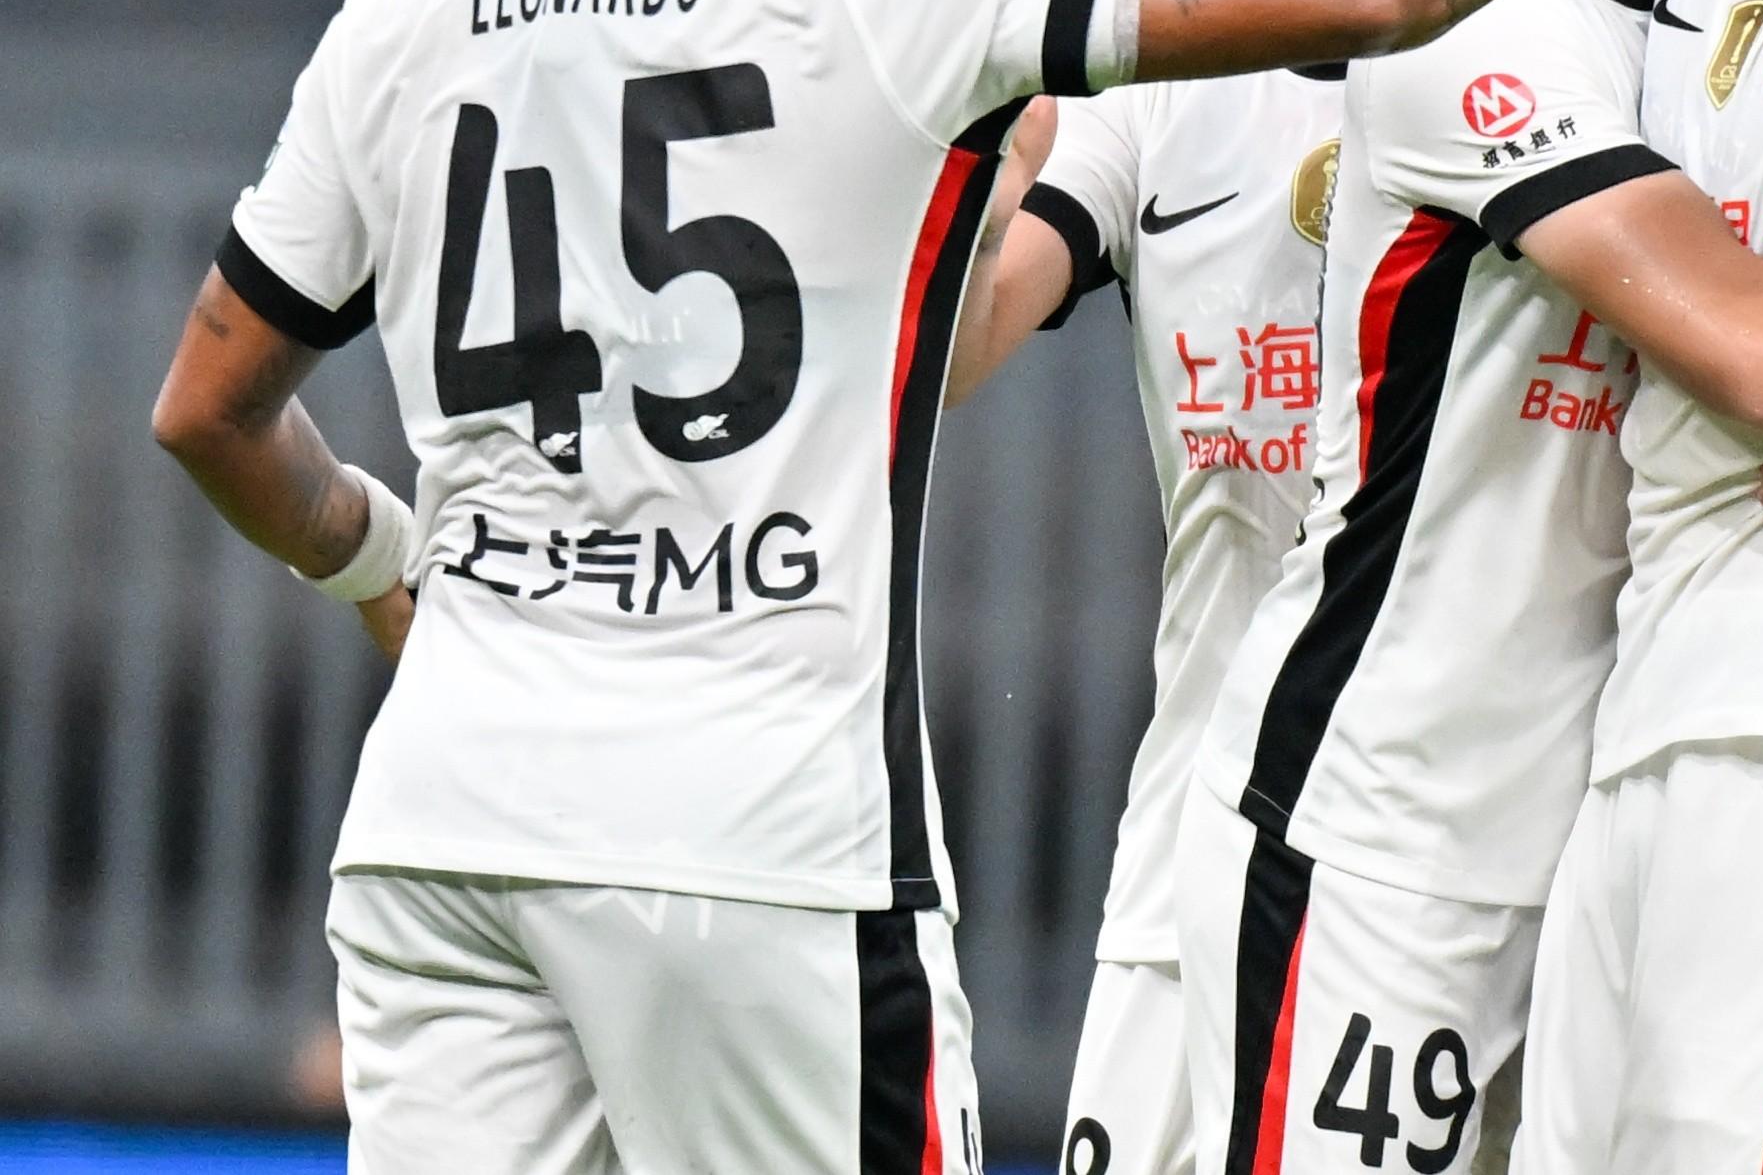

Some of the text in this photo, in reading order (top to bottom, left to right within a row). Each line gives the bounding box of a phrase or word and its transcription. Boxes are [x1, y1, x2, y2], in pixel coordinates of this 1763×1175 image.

[433, 62, 804, 475] 45
[1176, 323, 1319, 411] 上海
[1537, 309, 1639, 374] 上
[1520, 378, 1623, 436] Bank
[1180, 423, 1308, 474] Bank of
[1313, 1012, 1477, 1175] 49
